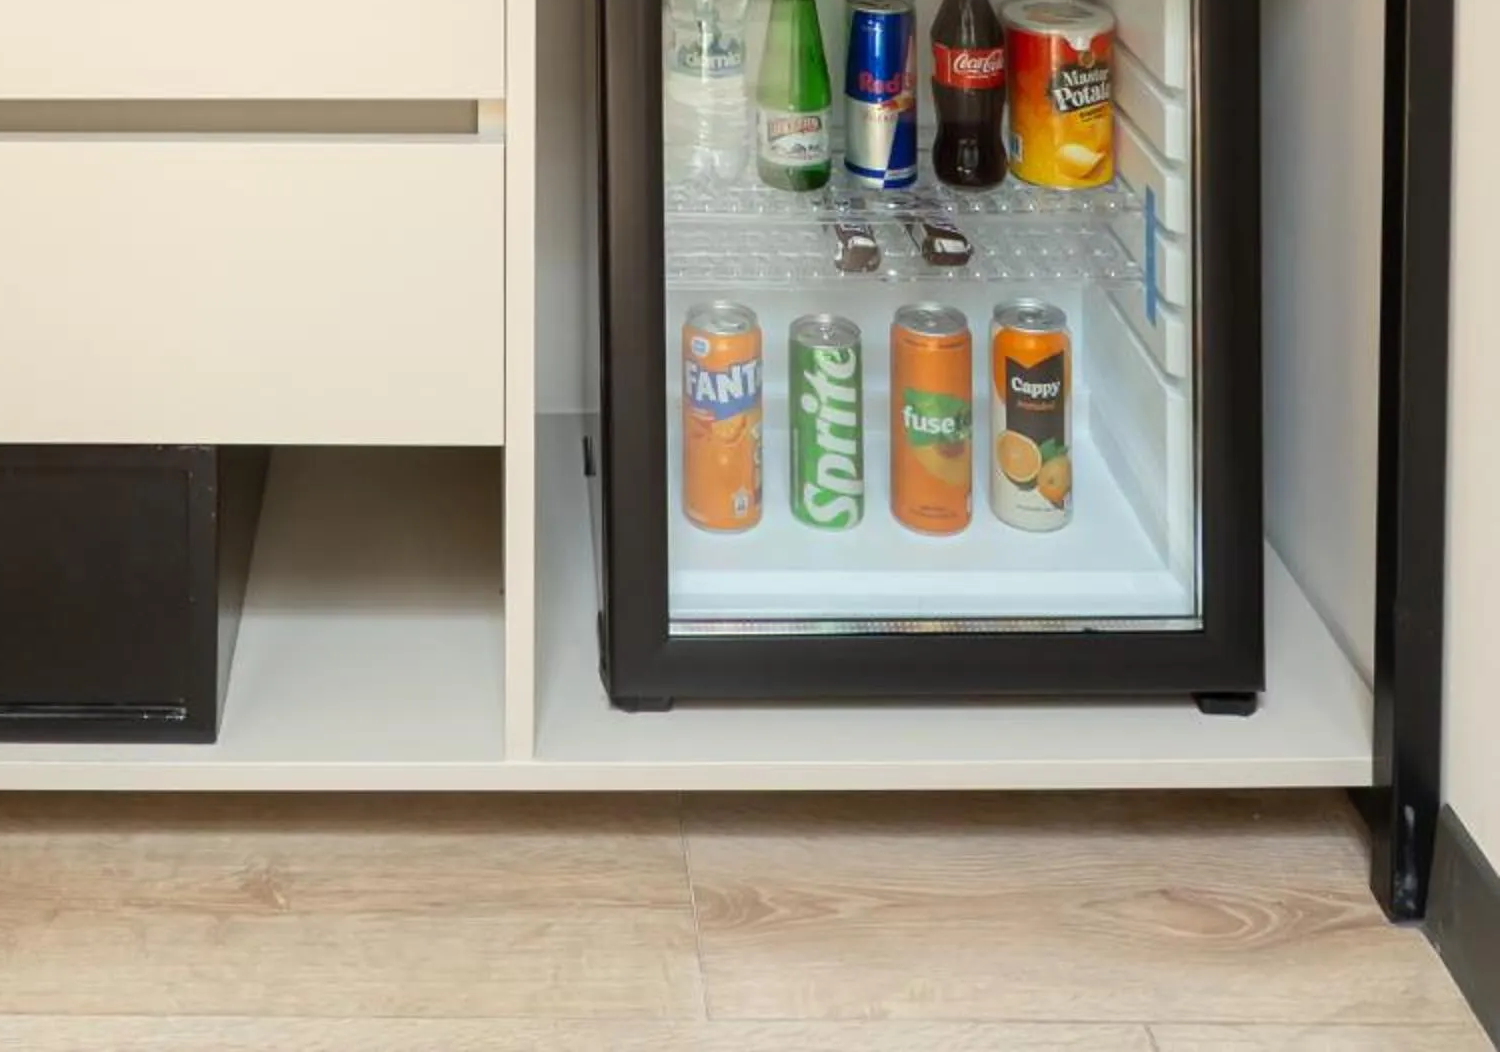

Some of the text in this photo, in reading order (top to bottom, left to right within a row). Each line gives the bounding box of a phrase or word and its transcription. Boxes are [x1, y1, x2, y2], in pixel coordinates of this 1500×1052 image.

[858, 70, 902, 93] Red
[1011, 377, 1061, 398] Cappy
[902, 405, 957, 434] fuse
[802, 346, 863, 528] Sprite
